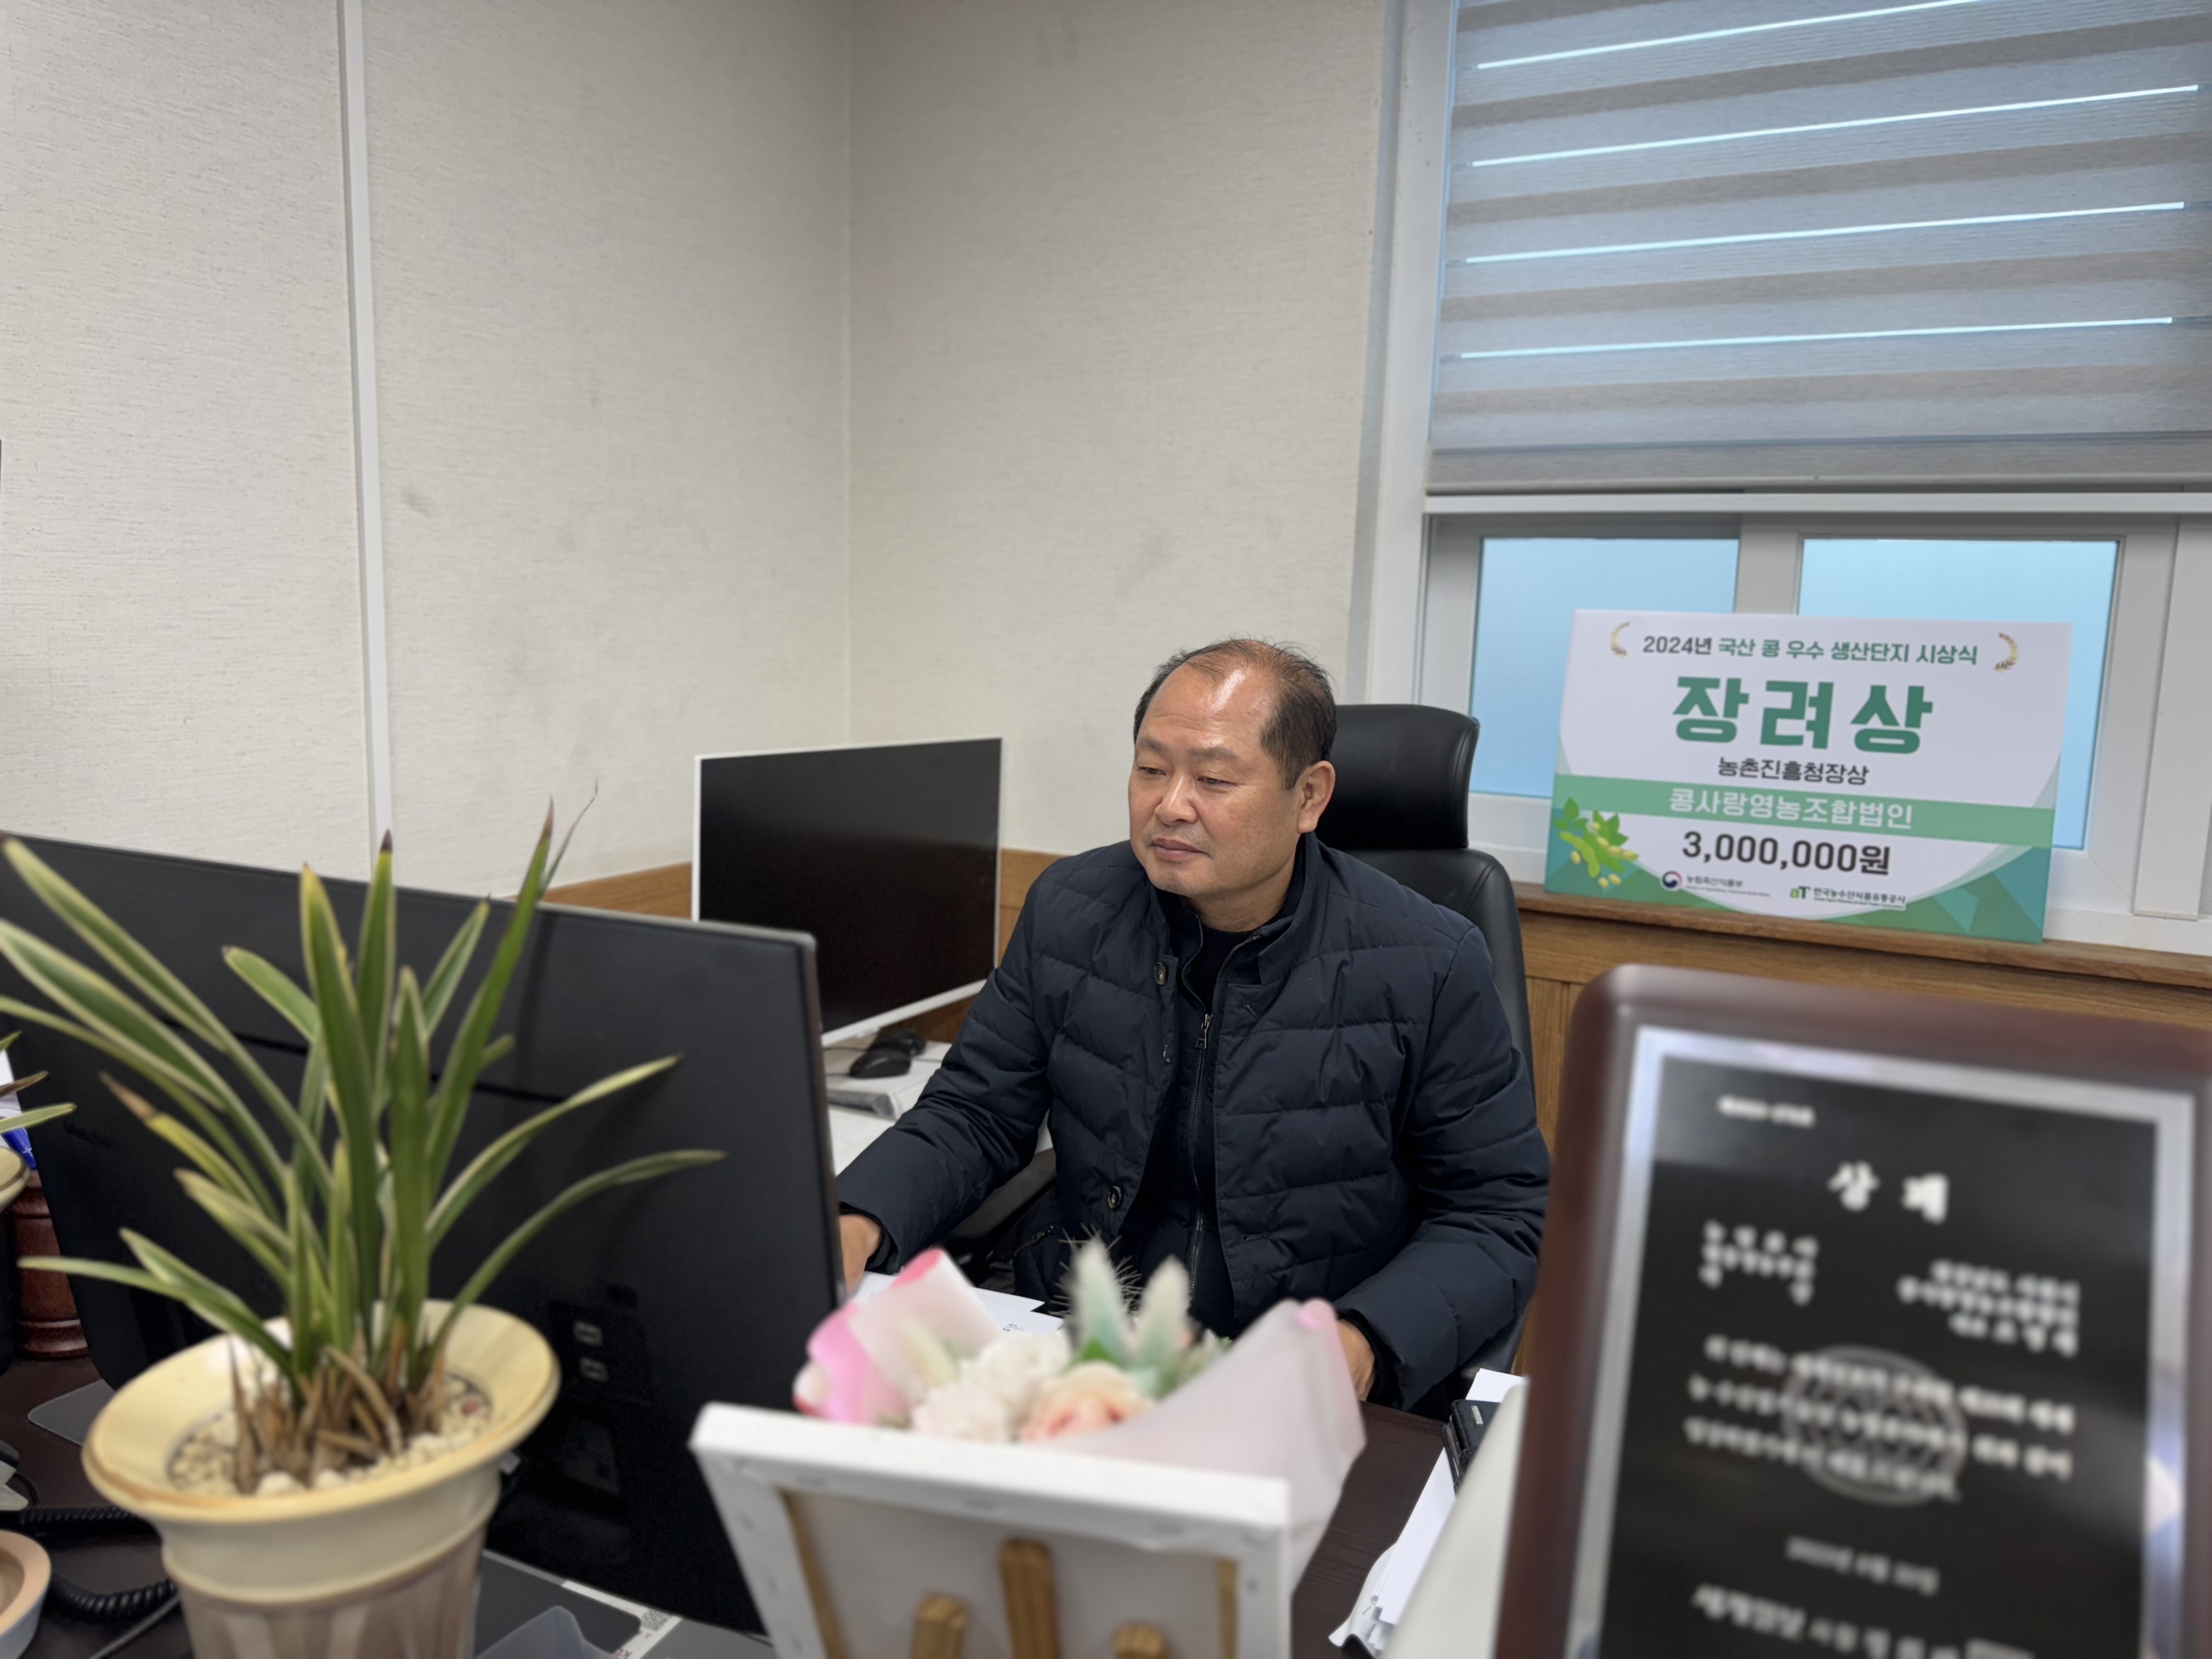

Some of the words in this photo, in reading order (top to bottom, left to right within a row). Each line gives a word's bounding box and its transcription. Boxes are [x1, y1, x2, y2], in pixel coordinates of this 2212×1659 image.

[1643, 635, 1712, 655] 2024년
[1718, 638, 1756, 657] 국산
[1761, 640, 1780, 658] 콩
[1786, 640, 1824, 659] 우수
[1831, 641, 1910, 663] 생산단지
[1916, 644, 1978, 665] 시상식
[1673, 675, 1933, 754] 장려상
[1718, 757, 1869, 785] 농촌진흥청장상
[1669, 787, 1913, 830] 콩사랑영농조합법인
[1682, 831, 1891, 876] 3,000,000원
